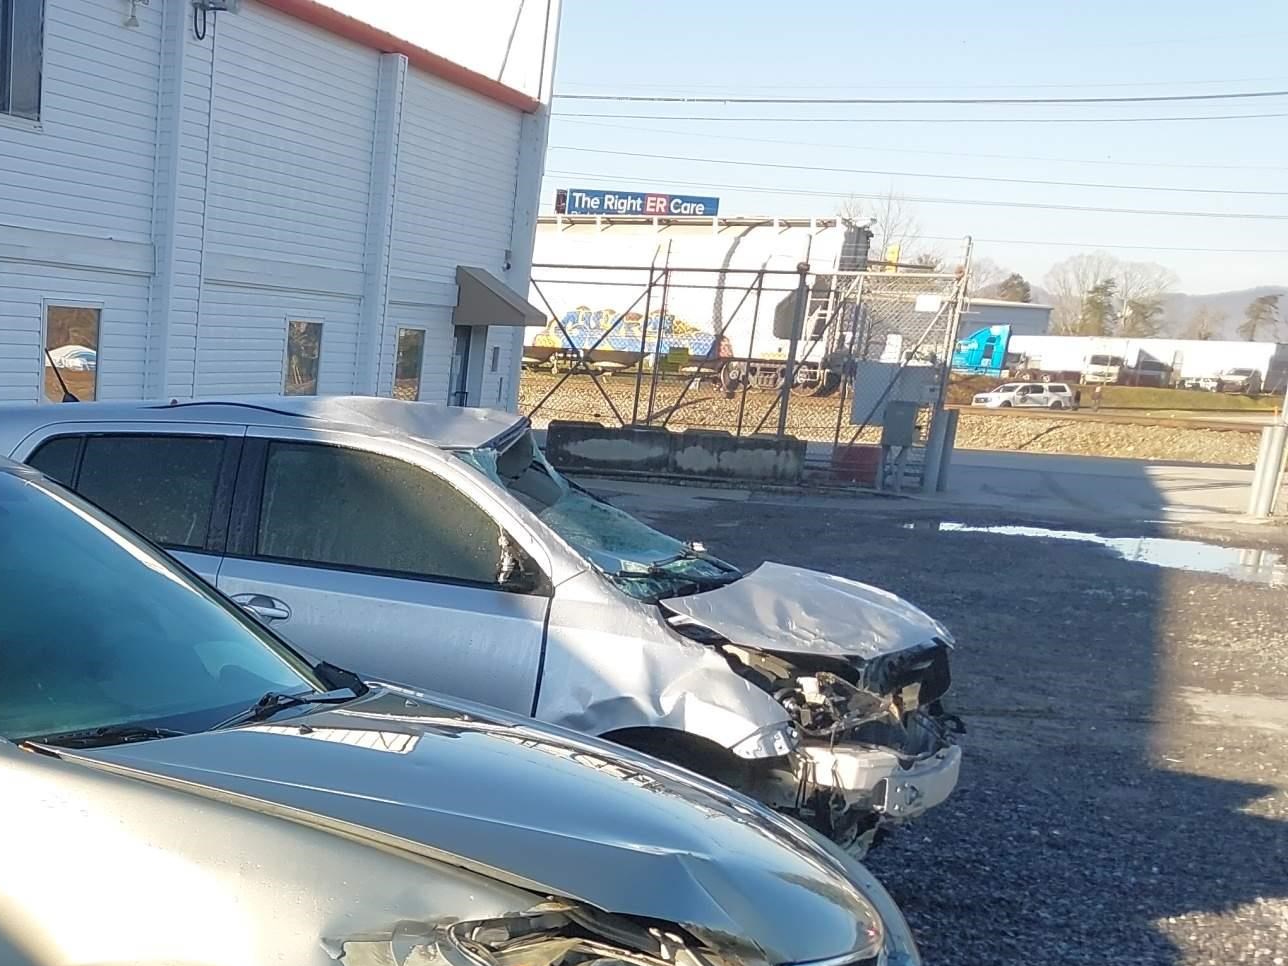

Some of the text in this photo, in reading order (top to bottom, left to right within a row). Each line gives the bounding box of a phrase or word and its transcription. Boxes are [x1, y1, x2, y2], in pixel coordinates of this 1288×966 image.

[572, 192, 705, 215] The Right ER Care
